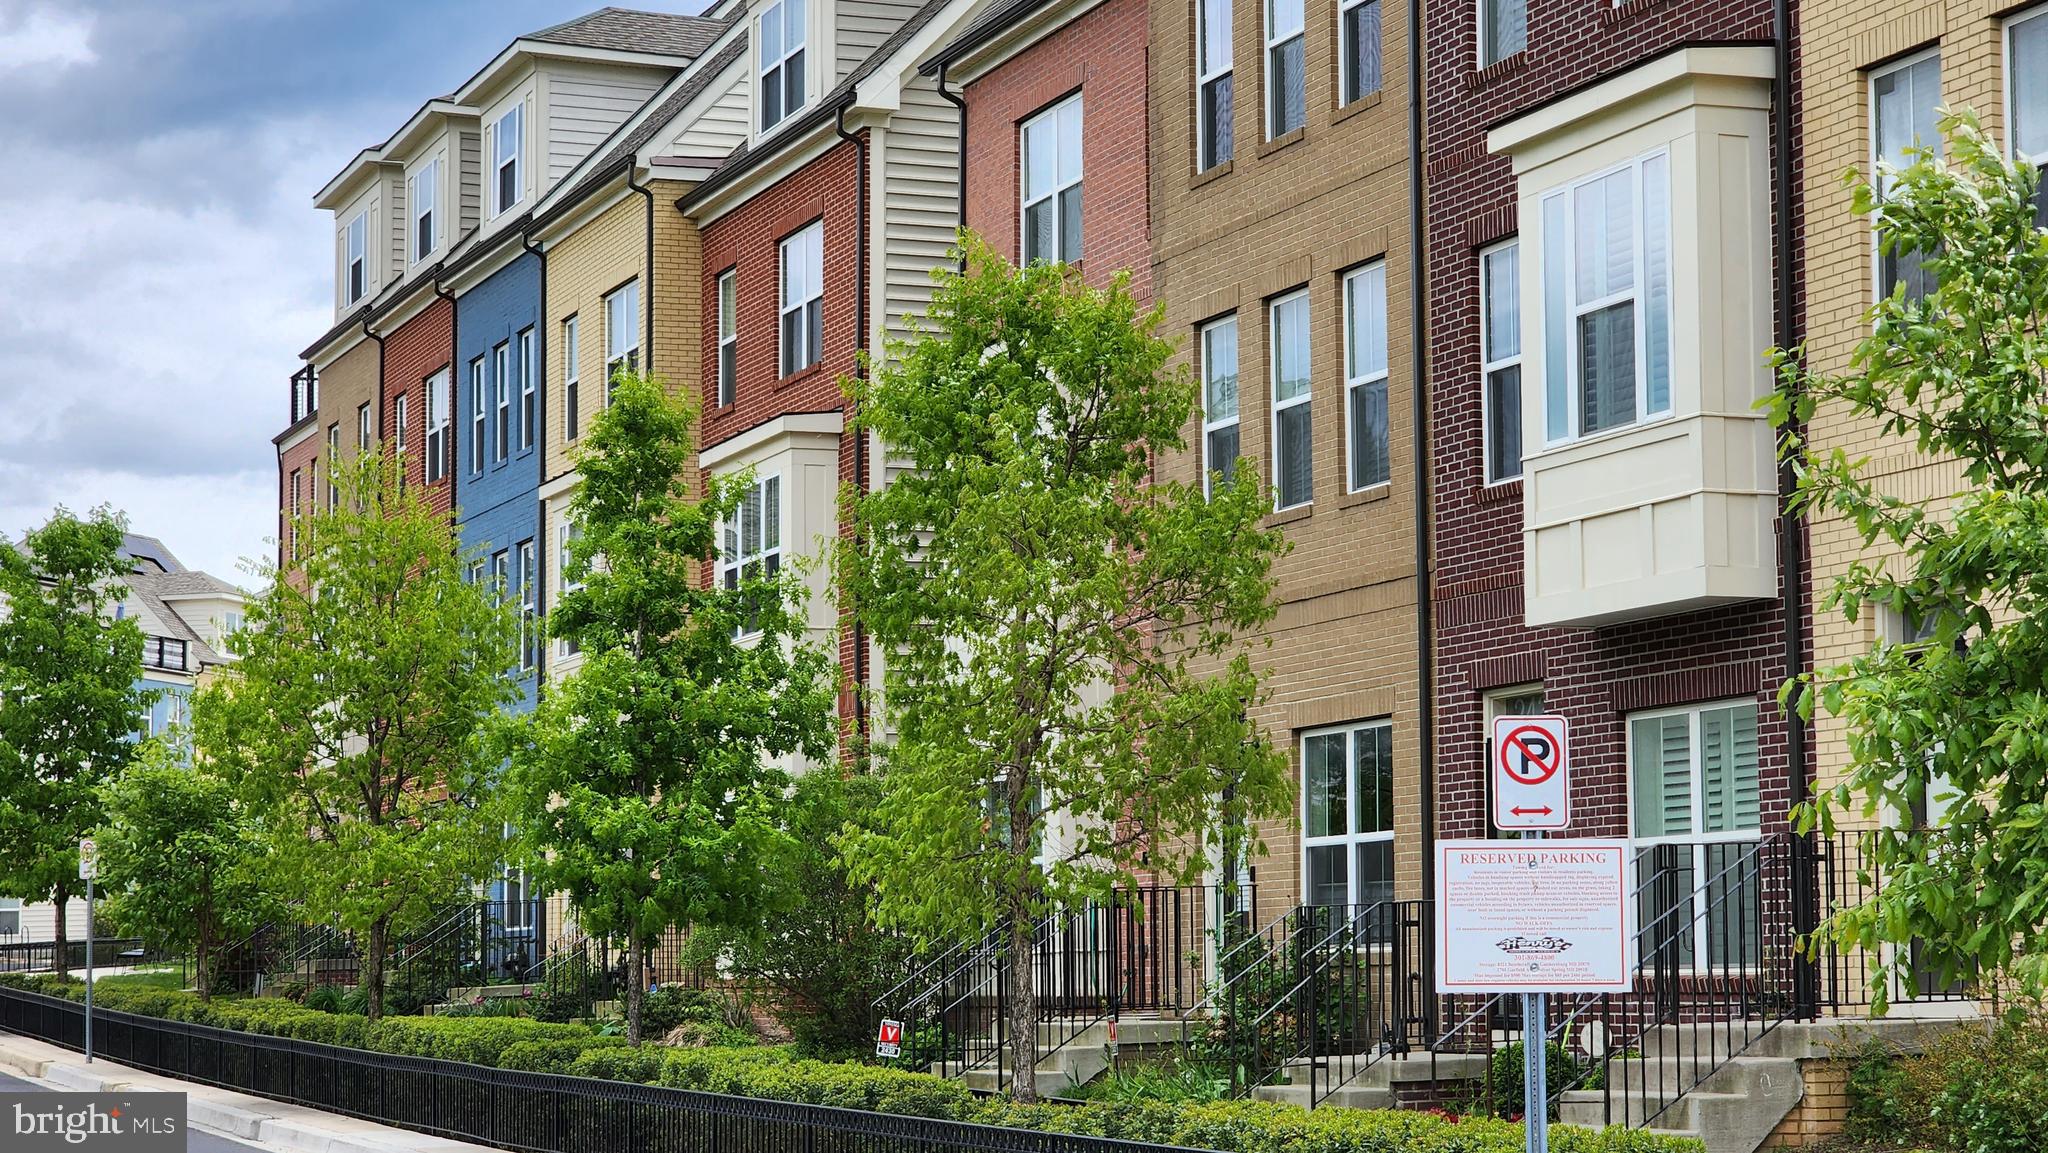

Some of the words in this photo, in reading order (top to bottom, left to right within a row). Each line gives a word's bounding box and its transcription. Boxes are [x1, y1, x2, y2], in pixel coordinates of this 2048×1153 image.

[1521, 738, 1550, 774] P
[1461, 853, 1536, 864] RESERVED
[1540, 852, 1606, 864] PARKING
[887, 1027, 898, 1041] V
